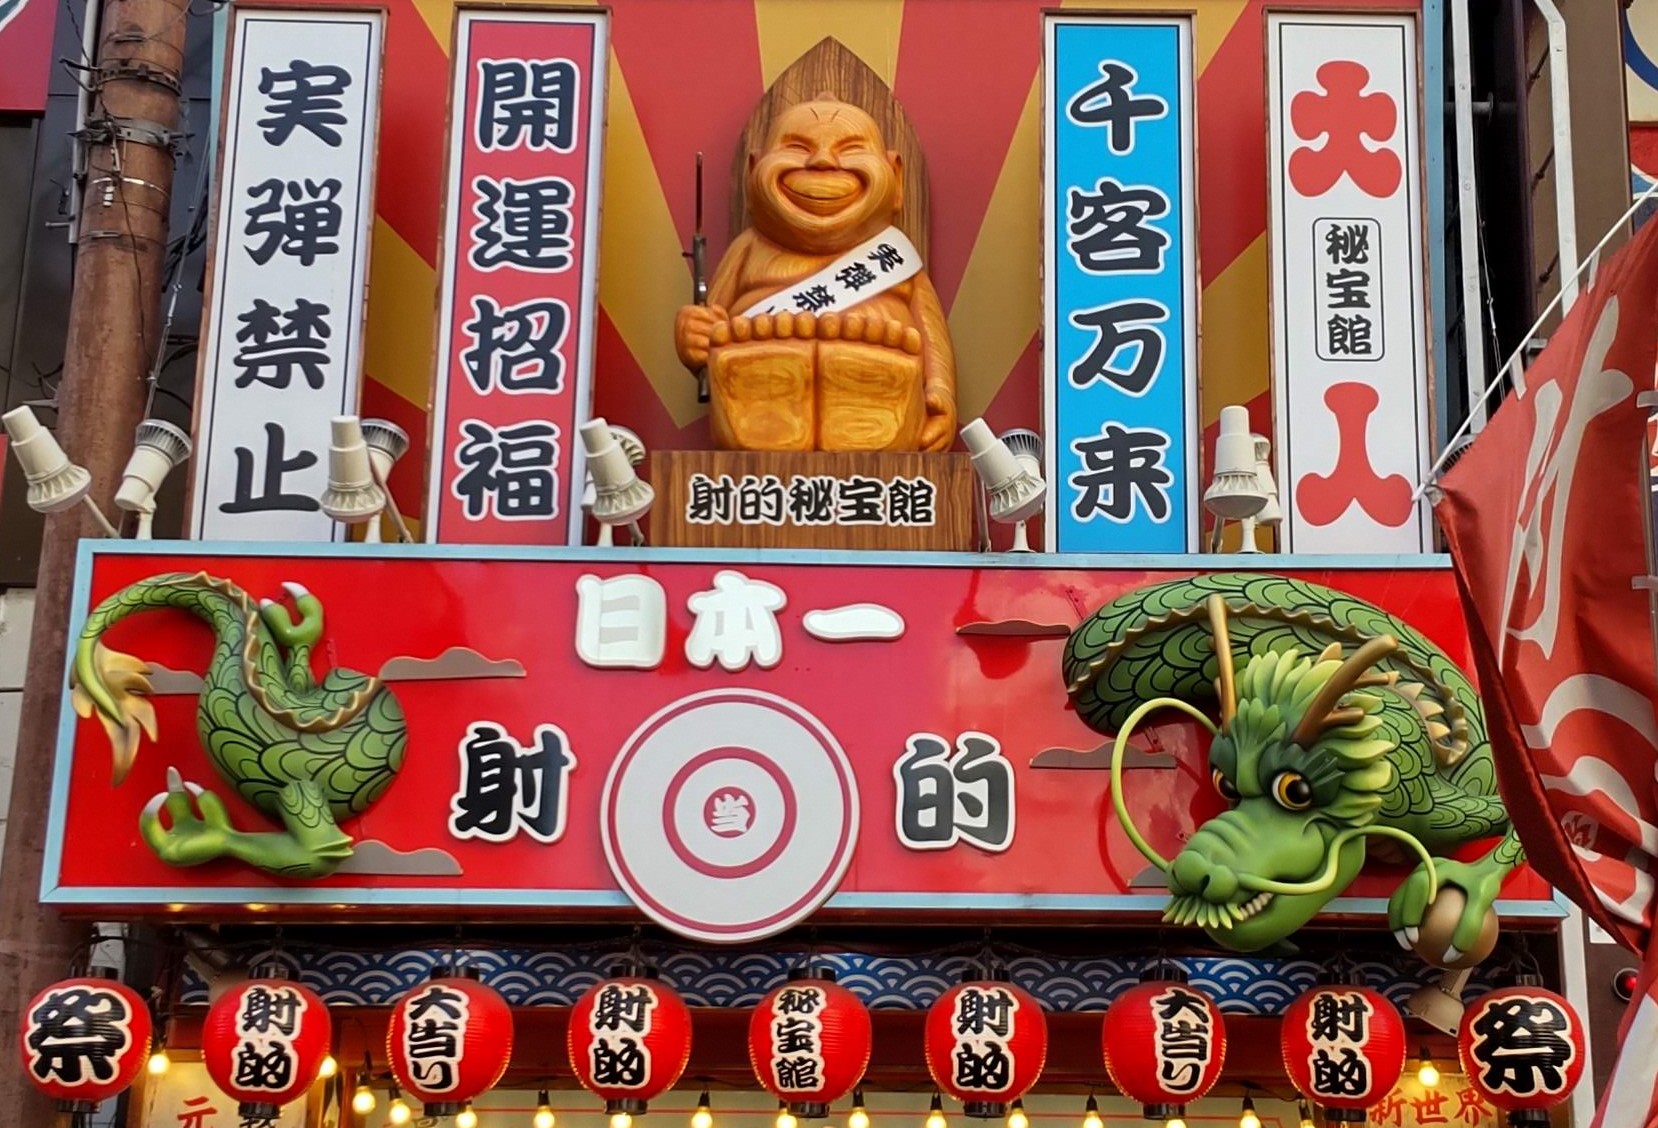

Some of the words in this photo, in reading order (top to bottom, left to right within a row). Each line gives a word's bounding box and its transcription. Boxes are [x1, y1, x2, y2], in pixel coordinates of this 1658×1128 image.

[220, 60, 352, 514] 実弾禁止
[453, 58, 578, 520] 開運招福
[766, 243, 904, 314] 実弾禁
[1068, 59, 1171, 523] 千客万来
[1325, 222, 1372, 355] 秘宝館
[688, 475, 935, 524] 射的秘宝館
[576, 570, 905, 671] 日本一
[451, 721, 575, 843] 射
[895, 732, 1015, 852] 的
[27, 987, 128, 1084] 祭
[234, 986, 303, 1089] 射的
[408, 986, 463, 1090] 大当り
[593, 984, 654, 1086] 射的
[775, 988, 820, 1089] 秘宝館
[955, 988, 1015, 1090] 射的
[1155, 989, 1210, 1091] 大当り
[1310, 993, 1369, 1096] 射的
[1472, 998, 1573, 1094] 祭
[1370, 1088, 1492, 1128] 新世界
